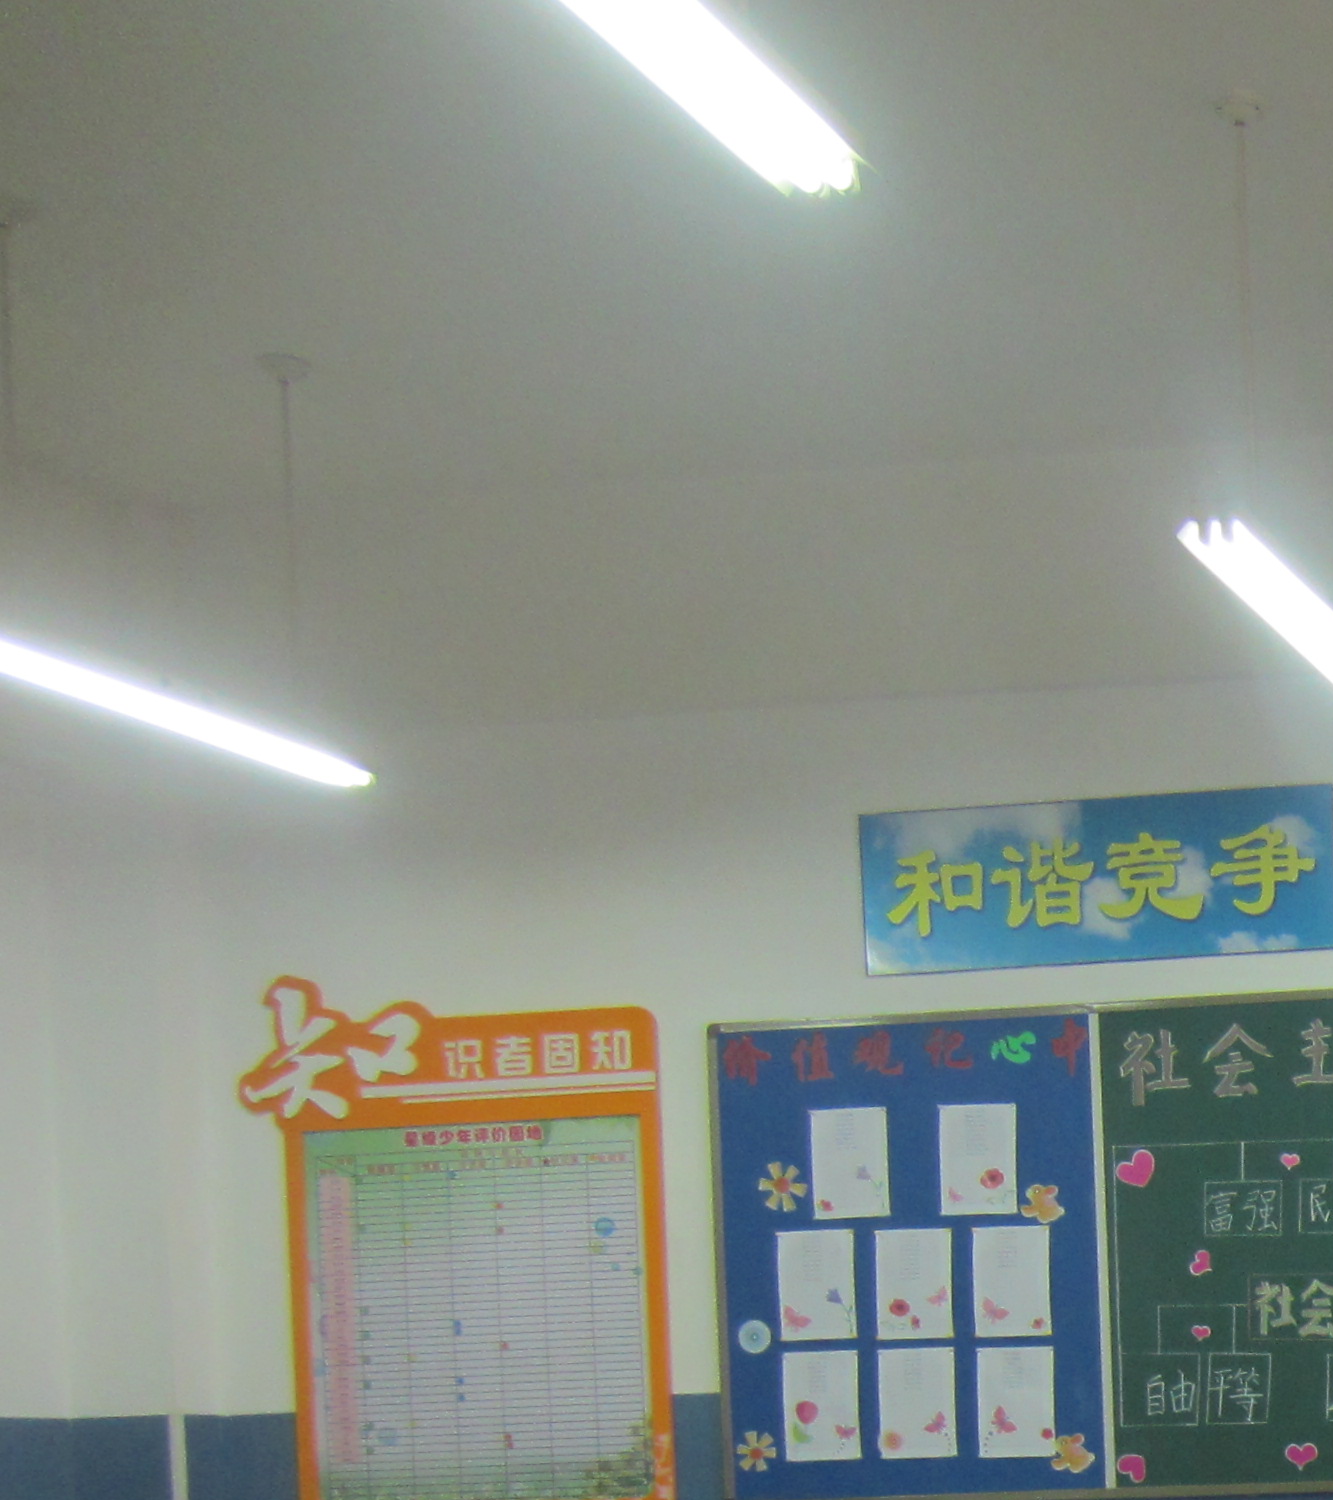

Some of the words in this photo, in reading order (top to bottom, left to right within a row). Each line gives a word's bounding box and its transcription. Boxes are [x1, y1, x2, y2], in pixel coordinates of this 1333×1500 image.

[886, 824, 1316, 937] 和谐竞争
[245, 986, 423, 1119] 知
[443, 1029, 632, 1080] 识者固知
[1207, 1189, 1279, 1232] 富强
[1146, 1369, 1196, 1416] 自由
[1208, 1367, 1264, 1424] 平等
